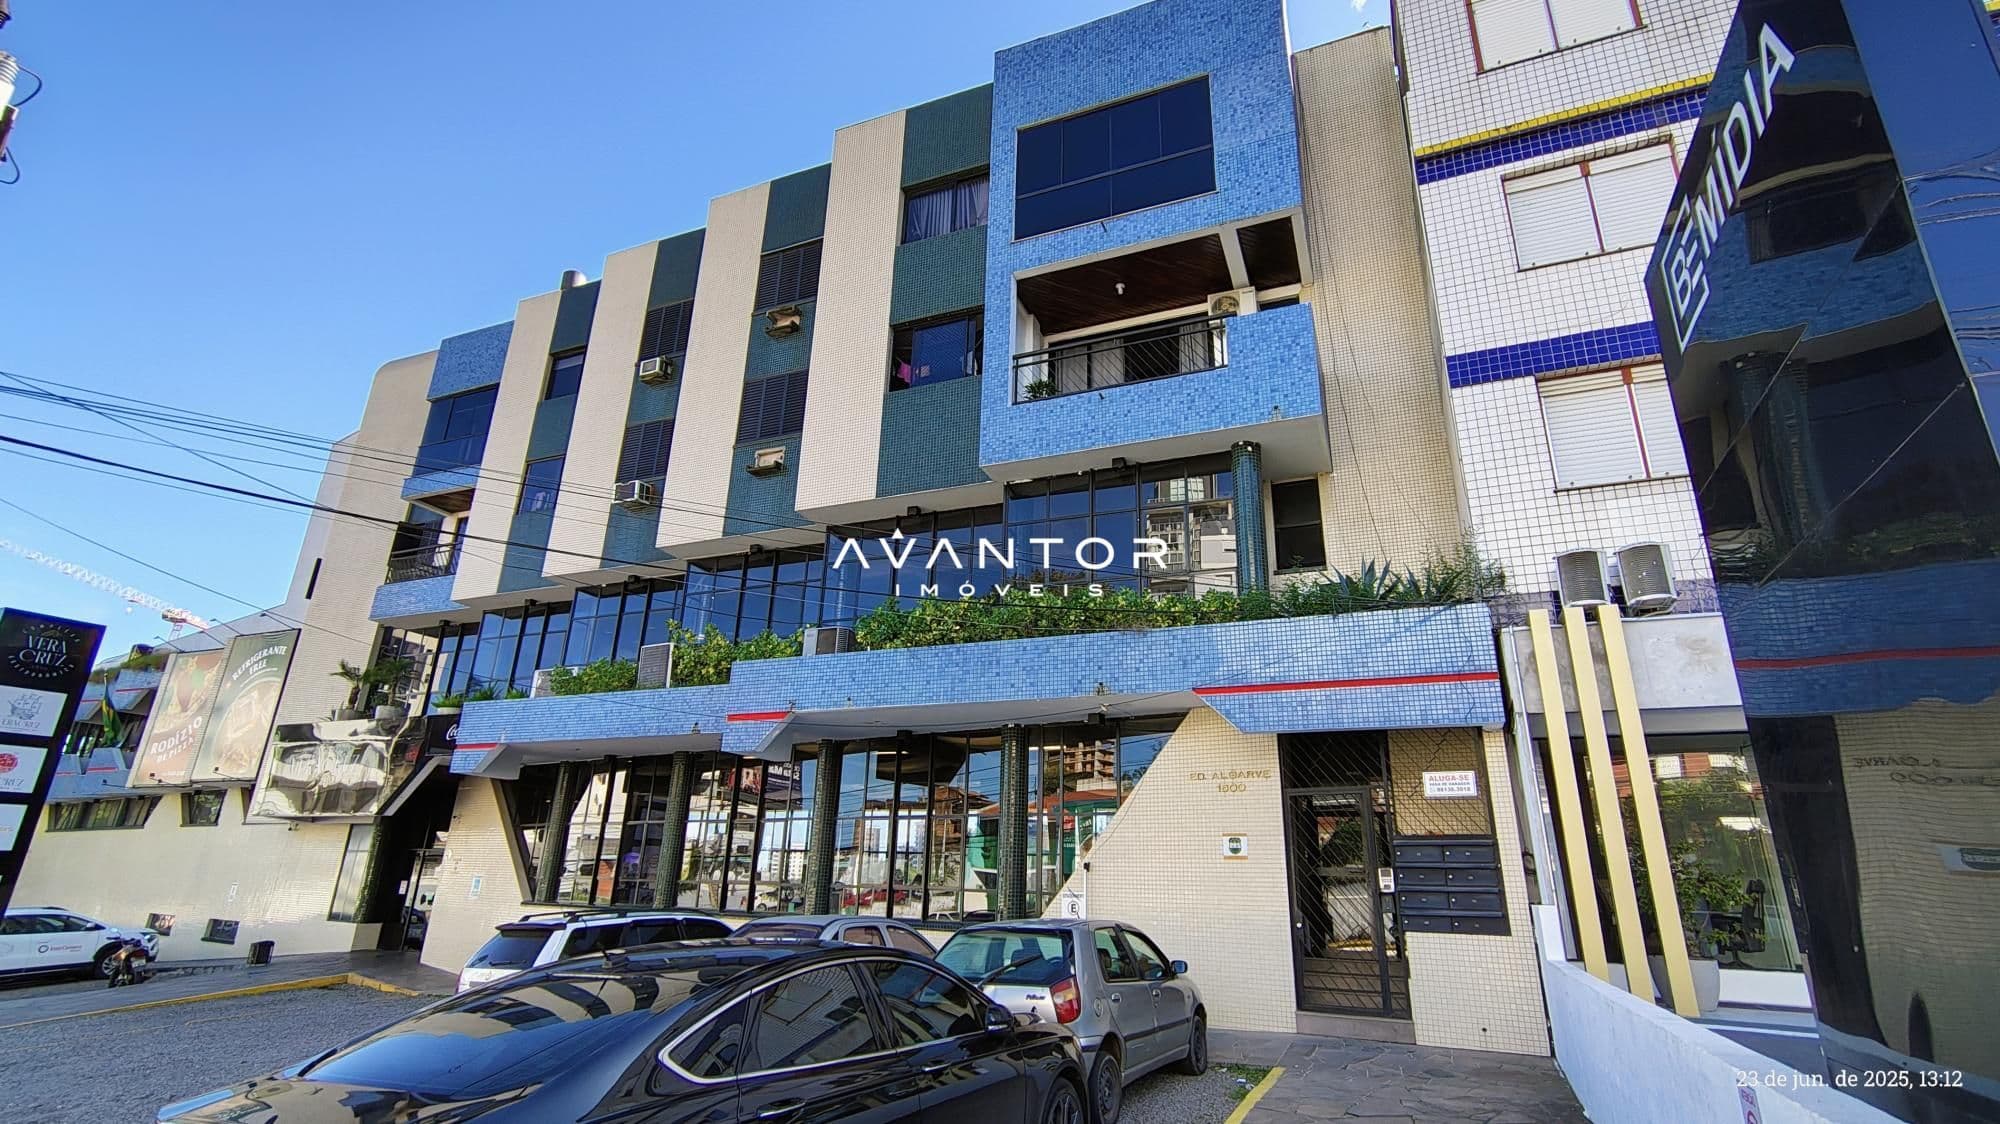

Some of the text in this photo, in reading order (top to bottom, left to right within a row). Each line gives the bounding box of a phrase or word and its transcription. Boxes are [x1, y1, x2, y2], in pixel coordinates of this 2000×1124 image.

[28, 635, 67, 654] VERA
[19, 648, 68, 666] CRUZ
[150, 715, 203, 755] RODÍZIO
[1211, 768, 1272, 780] ALGARVE
